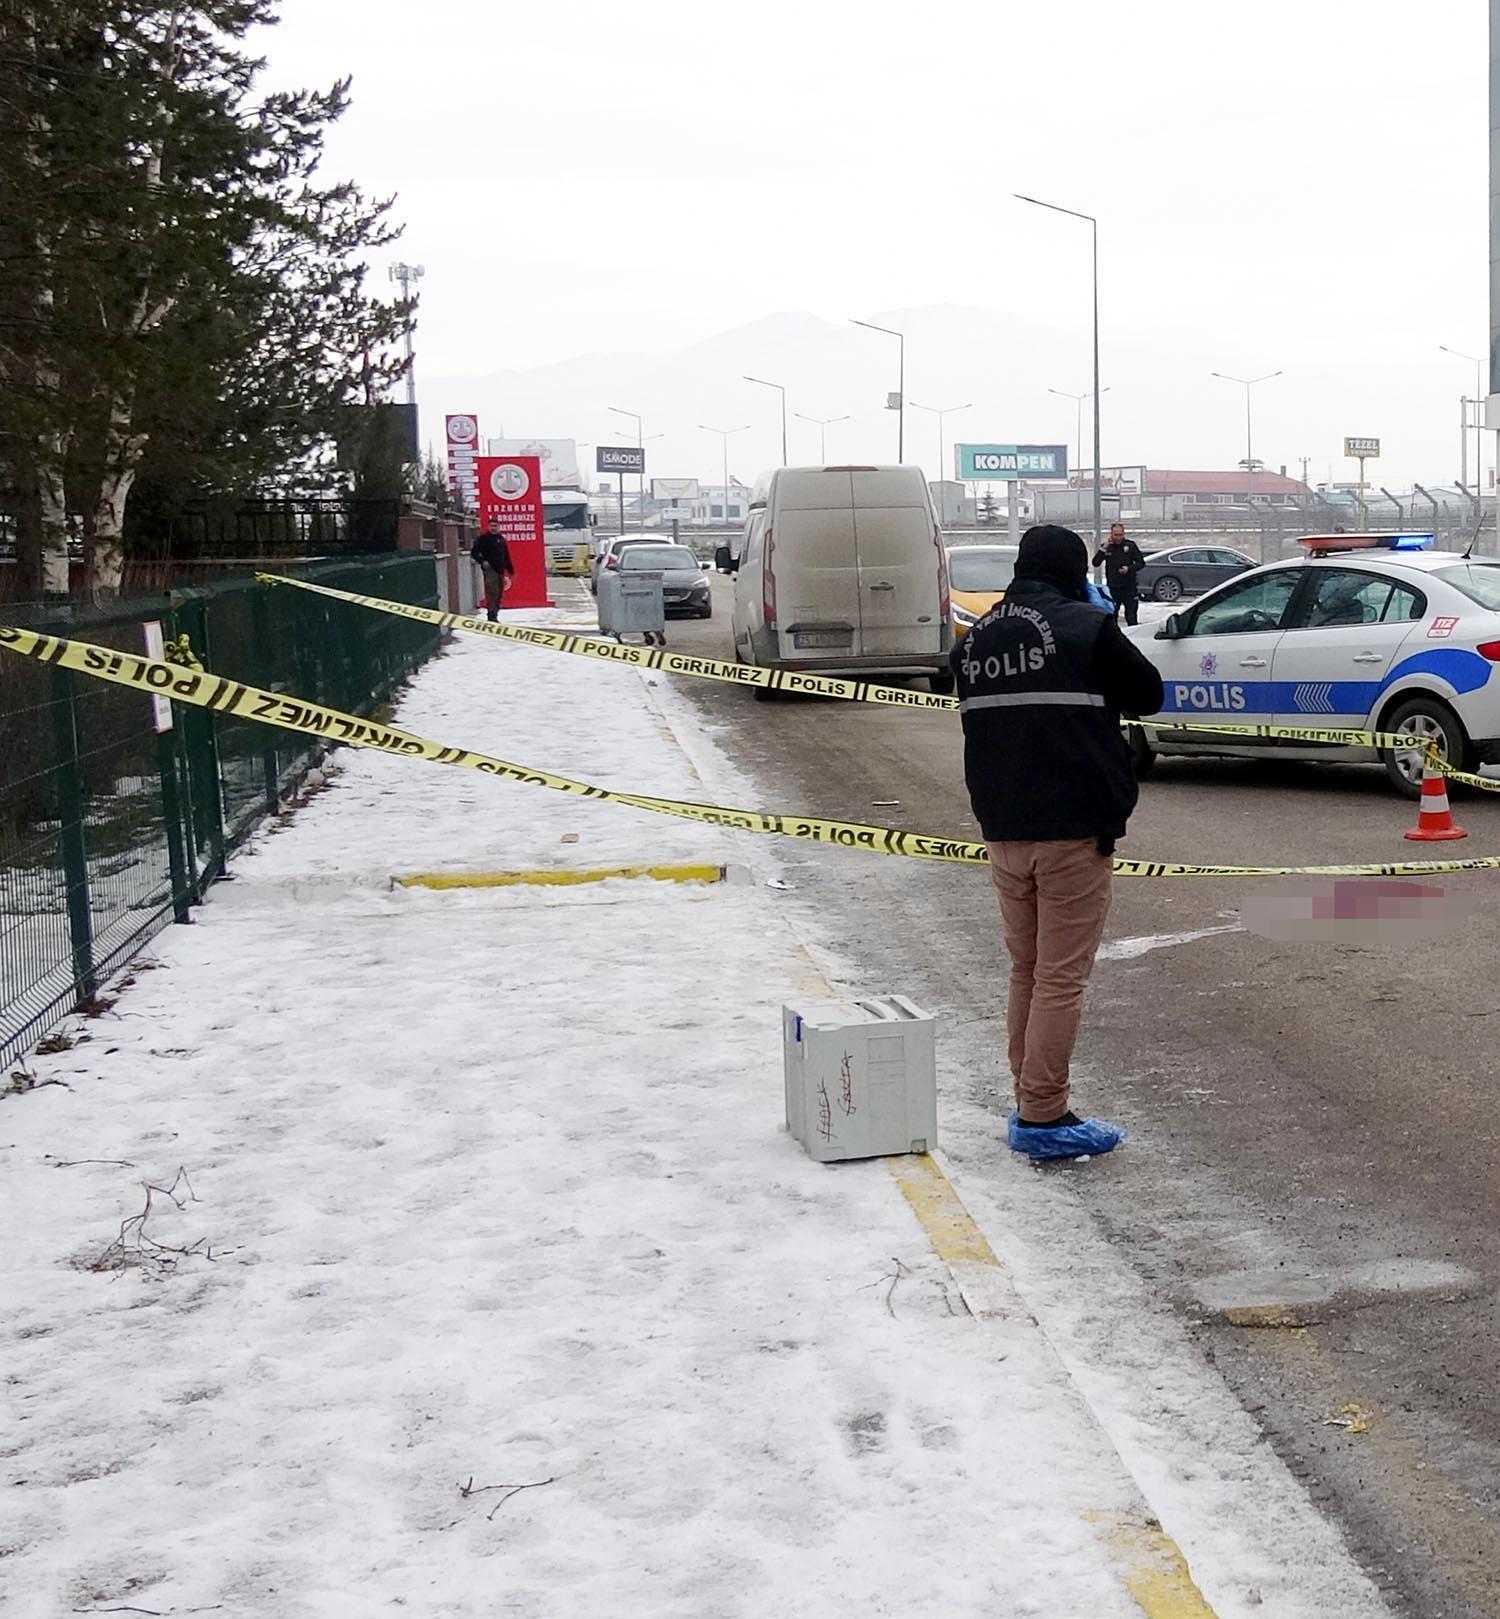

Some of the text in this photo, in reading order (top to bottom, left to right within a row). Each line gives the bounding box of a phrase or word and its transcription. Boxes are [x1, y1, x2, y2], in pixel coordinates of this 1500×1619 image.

[975, 455, 1055, 470] KOMPEN
[84, 648, 202, 697] POLİS
[583, 642, 641, 662] POLİS
[670, 656, 762, 683] GİRİLMEZ
[790, 676, 846, 695] POLİS
[970, 643, 1045, 684] POLİS
[1175, 683, 1246, 709] POLİS
